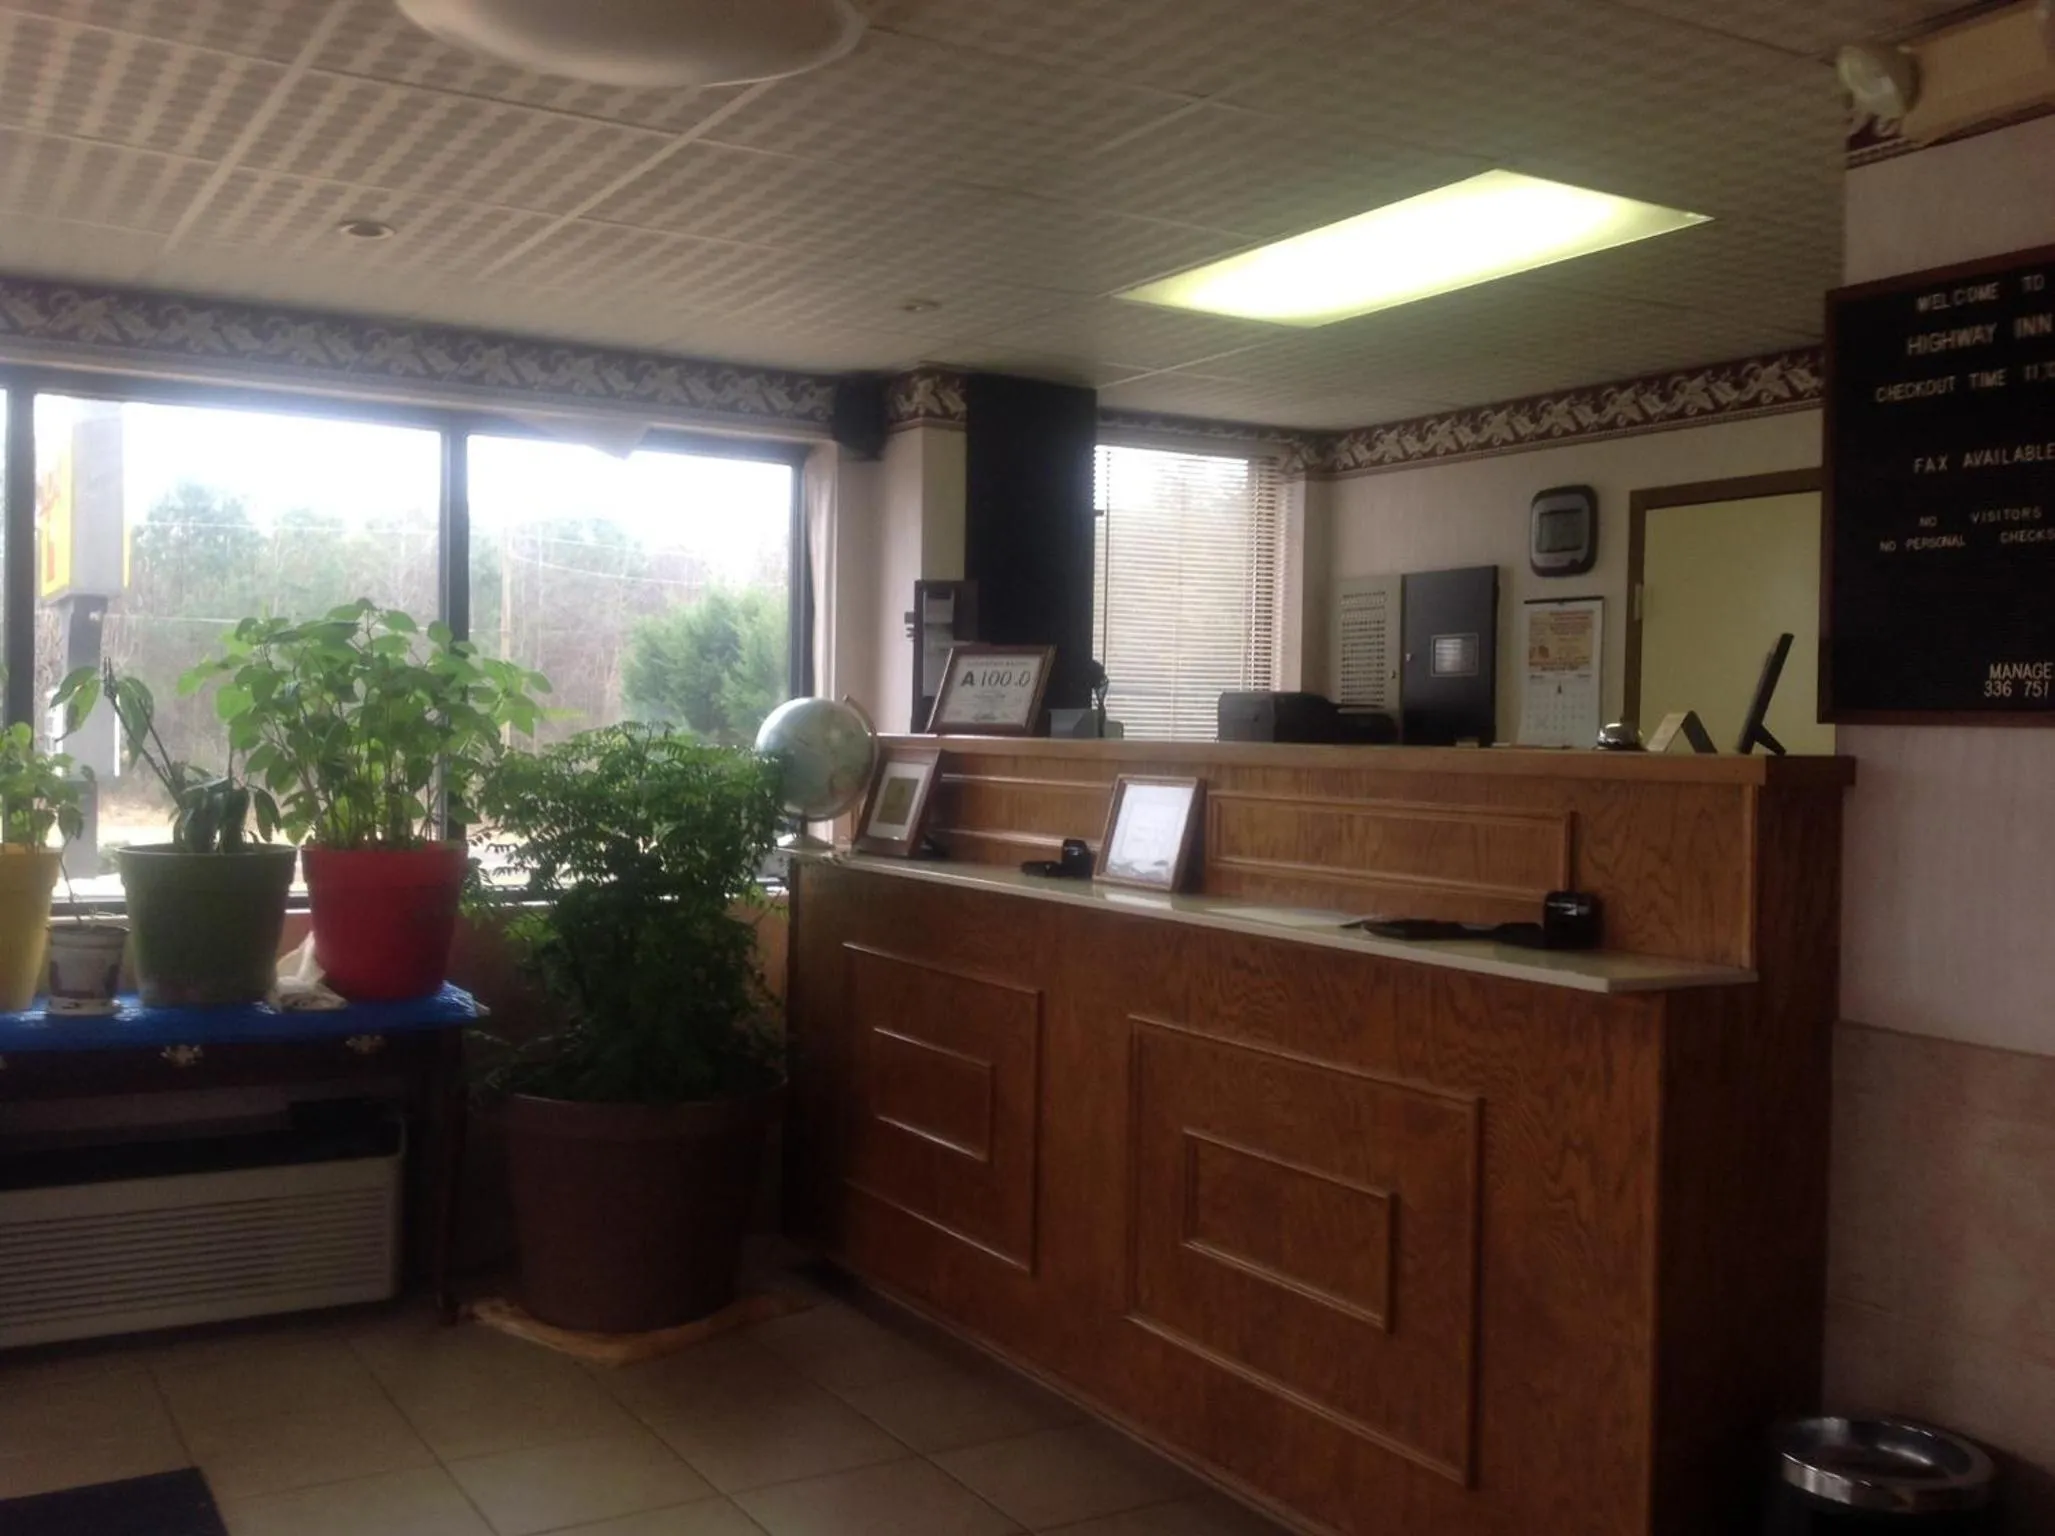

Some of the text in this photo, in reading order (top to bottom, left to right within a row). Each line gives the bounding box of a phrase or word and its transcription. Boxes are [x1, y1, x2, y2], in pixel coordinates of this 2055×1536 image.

[1917, 273, 2045, 312] WELCOME TO
[1907, 313, 2053, 355] HIGHWAY INN
[1875, 375, 1955, 402] CHECKOUT
[1967, 368, 2007, 389] TIME
[1913, 442, 2055, 474] FAX AVAILABLE
[1919, 506, 2042, 527] NO VISITORS
[1879, 541, 1897, 552] NO
[1905, 534, 1966, 550] PERSONAL
[961, 671, 975, 687] A
[1989, 662, 2053, 681] MANAGE
[1984, 680, 2012, 698] 336
